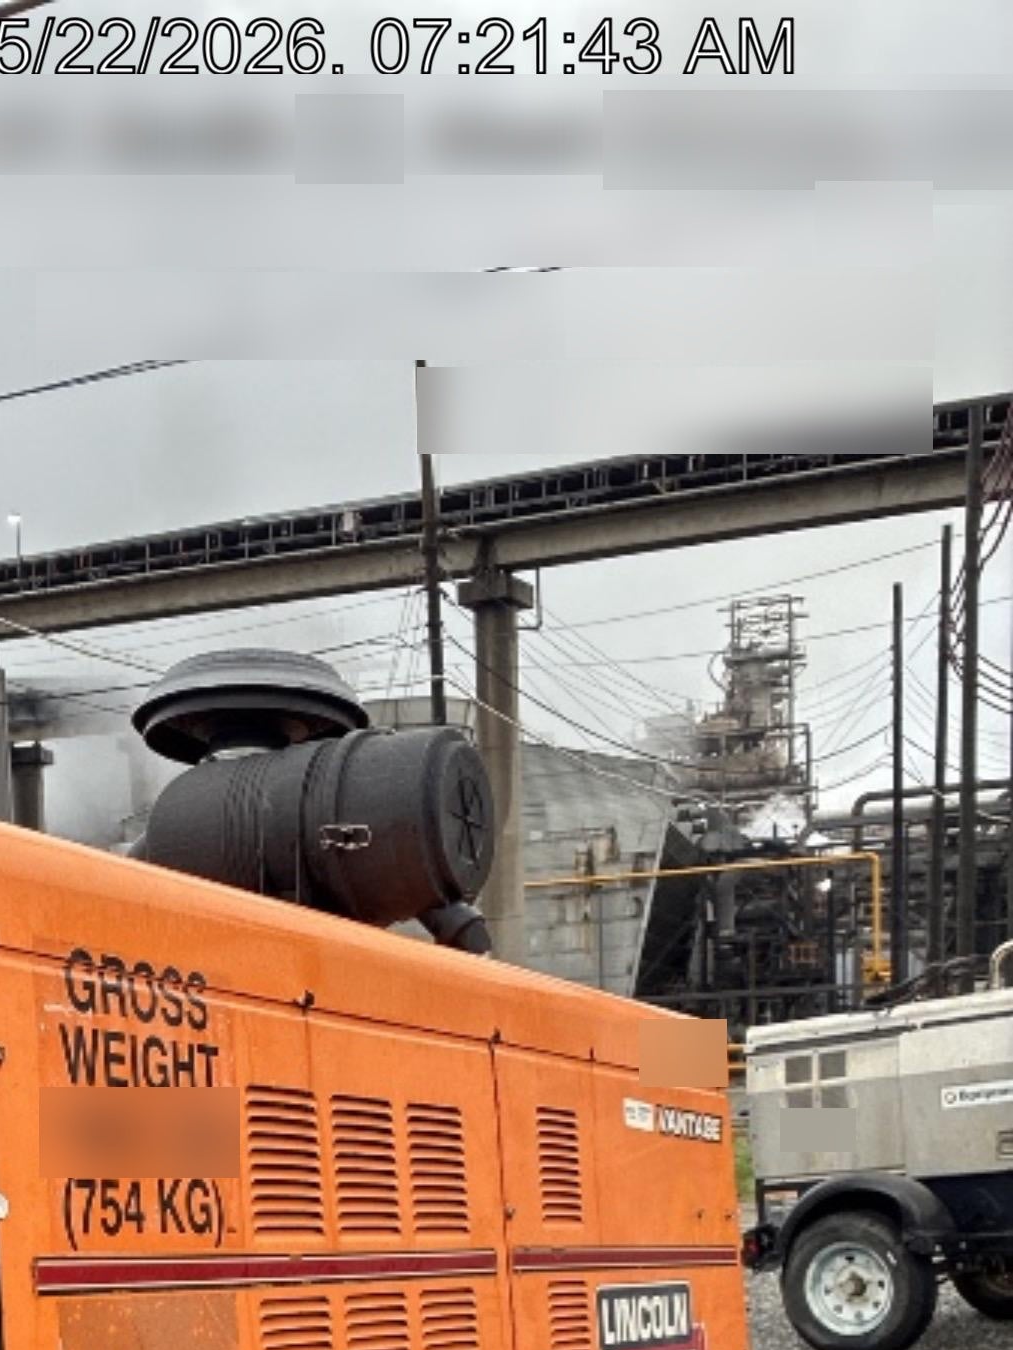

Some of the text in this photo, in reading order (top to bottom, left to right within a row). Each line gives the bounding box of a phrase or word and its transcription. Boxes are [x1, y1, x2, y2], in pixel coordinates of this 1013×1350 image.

[64, 948, 208, 1030] GROSS
[59, 1022, 219, 1087] WEIGHT
[64, 1177, 225, 1251] (754 KG)
[601, 1293, 688, 1345] LINCOLN
